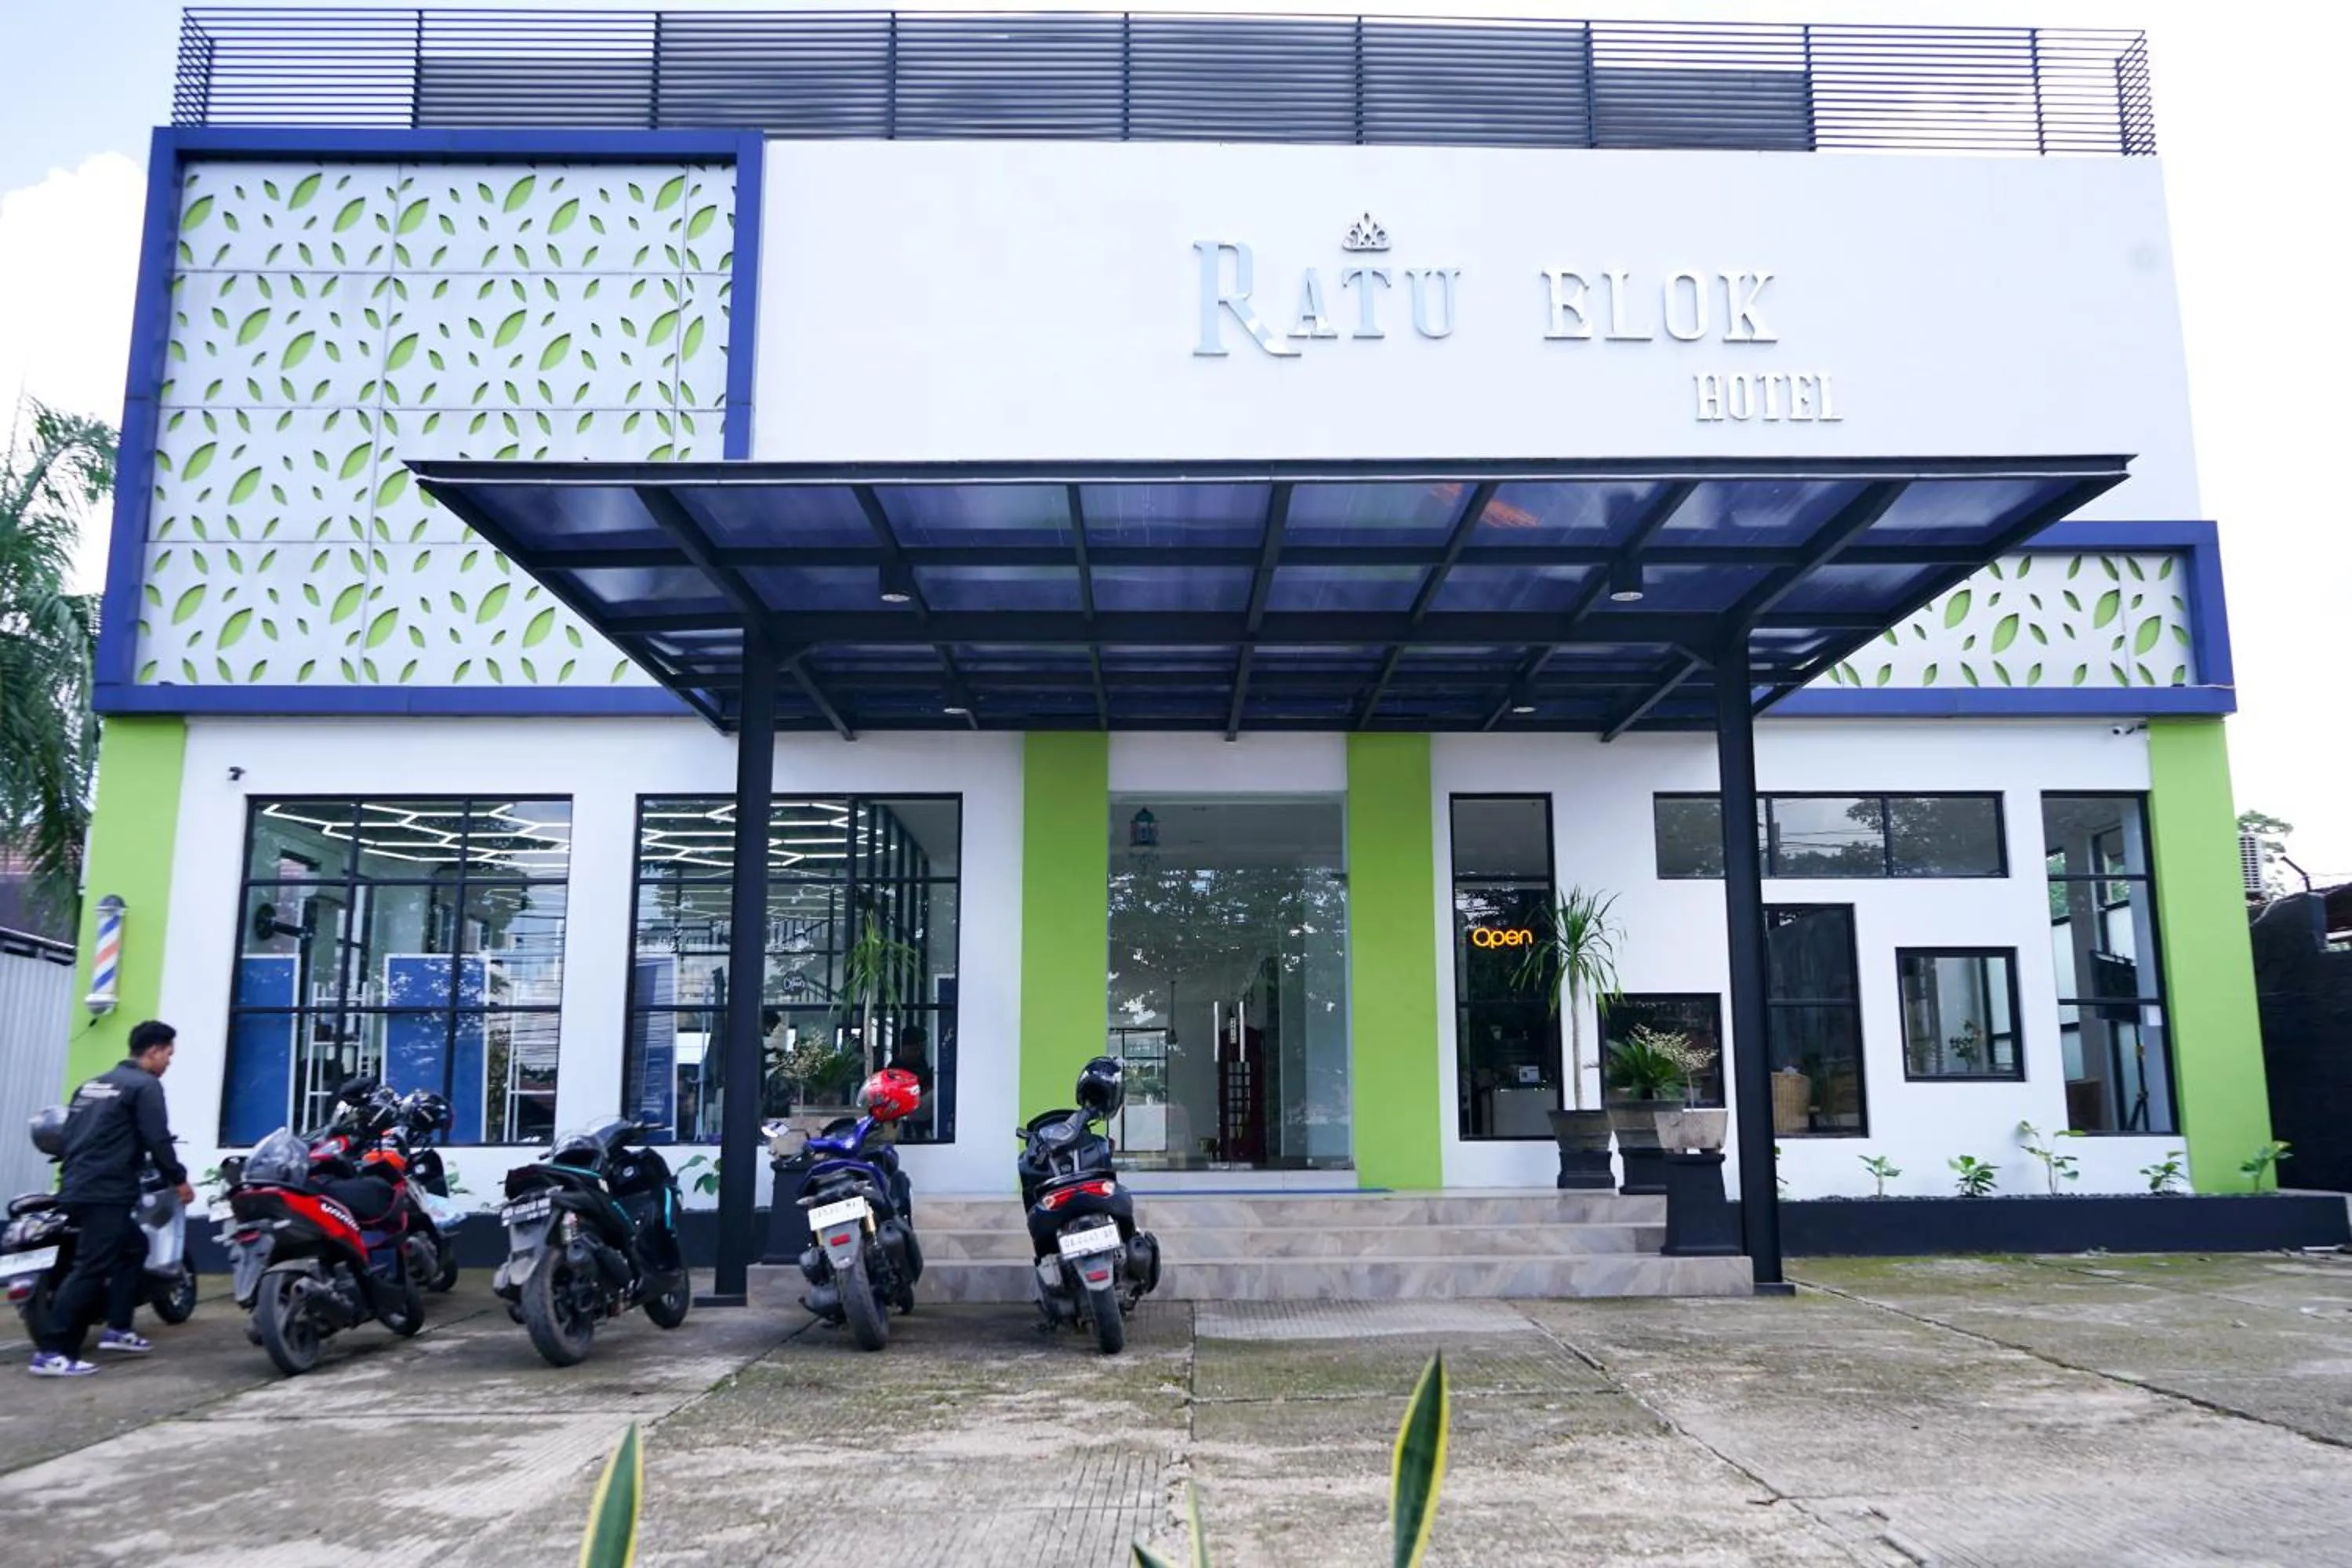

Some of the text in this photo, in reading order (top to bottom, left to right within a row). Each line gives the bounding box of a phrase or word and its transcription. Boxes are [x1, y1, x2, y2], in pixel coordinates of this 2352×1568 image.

[1192, 240, 1780, 358] RATU ELOK
[1692, 372, 1844, 422] HOTEL
[1473, 927, 1533, 949] Open
